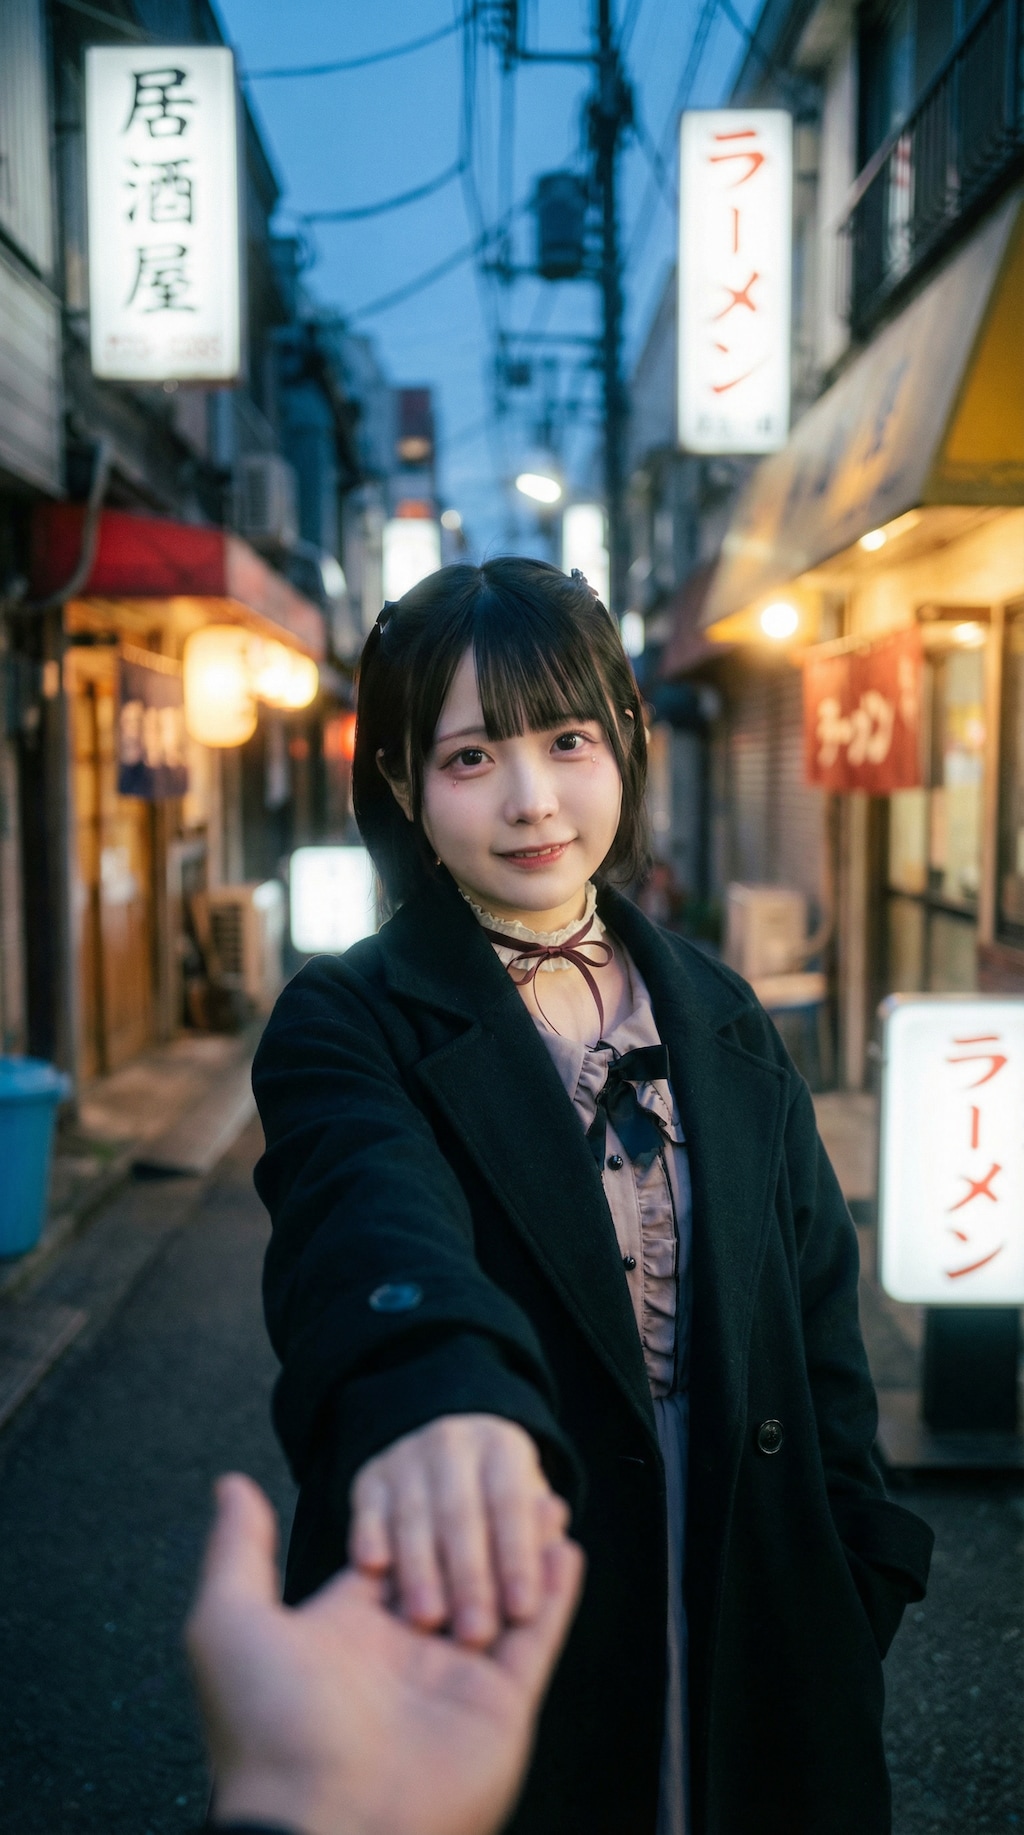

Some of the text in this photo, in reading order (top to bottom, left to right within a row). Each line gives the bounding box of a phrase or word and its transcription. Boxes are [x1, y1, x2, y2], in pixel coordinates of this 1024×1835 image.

[124, 67, 195, 314] 居酒屋
[708, 129, 771, 395] ラーメン
[947, 1035, 1008, 1280] ラーメン
